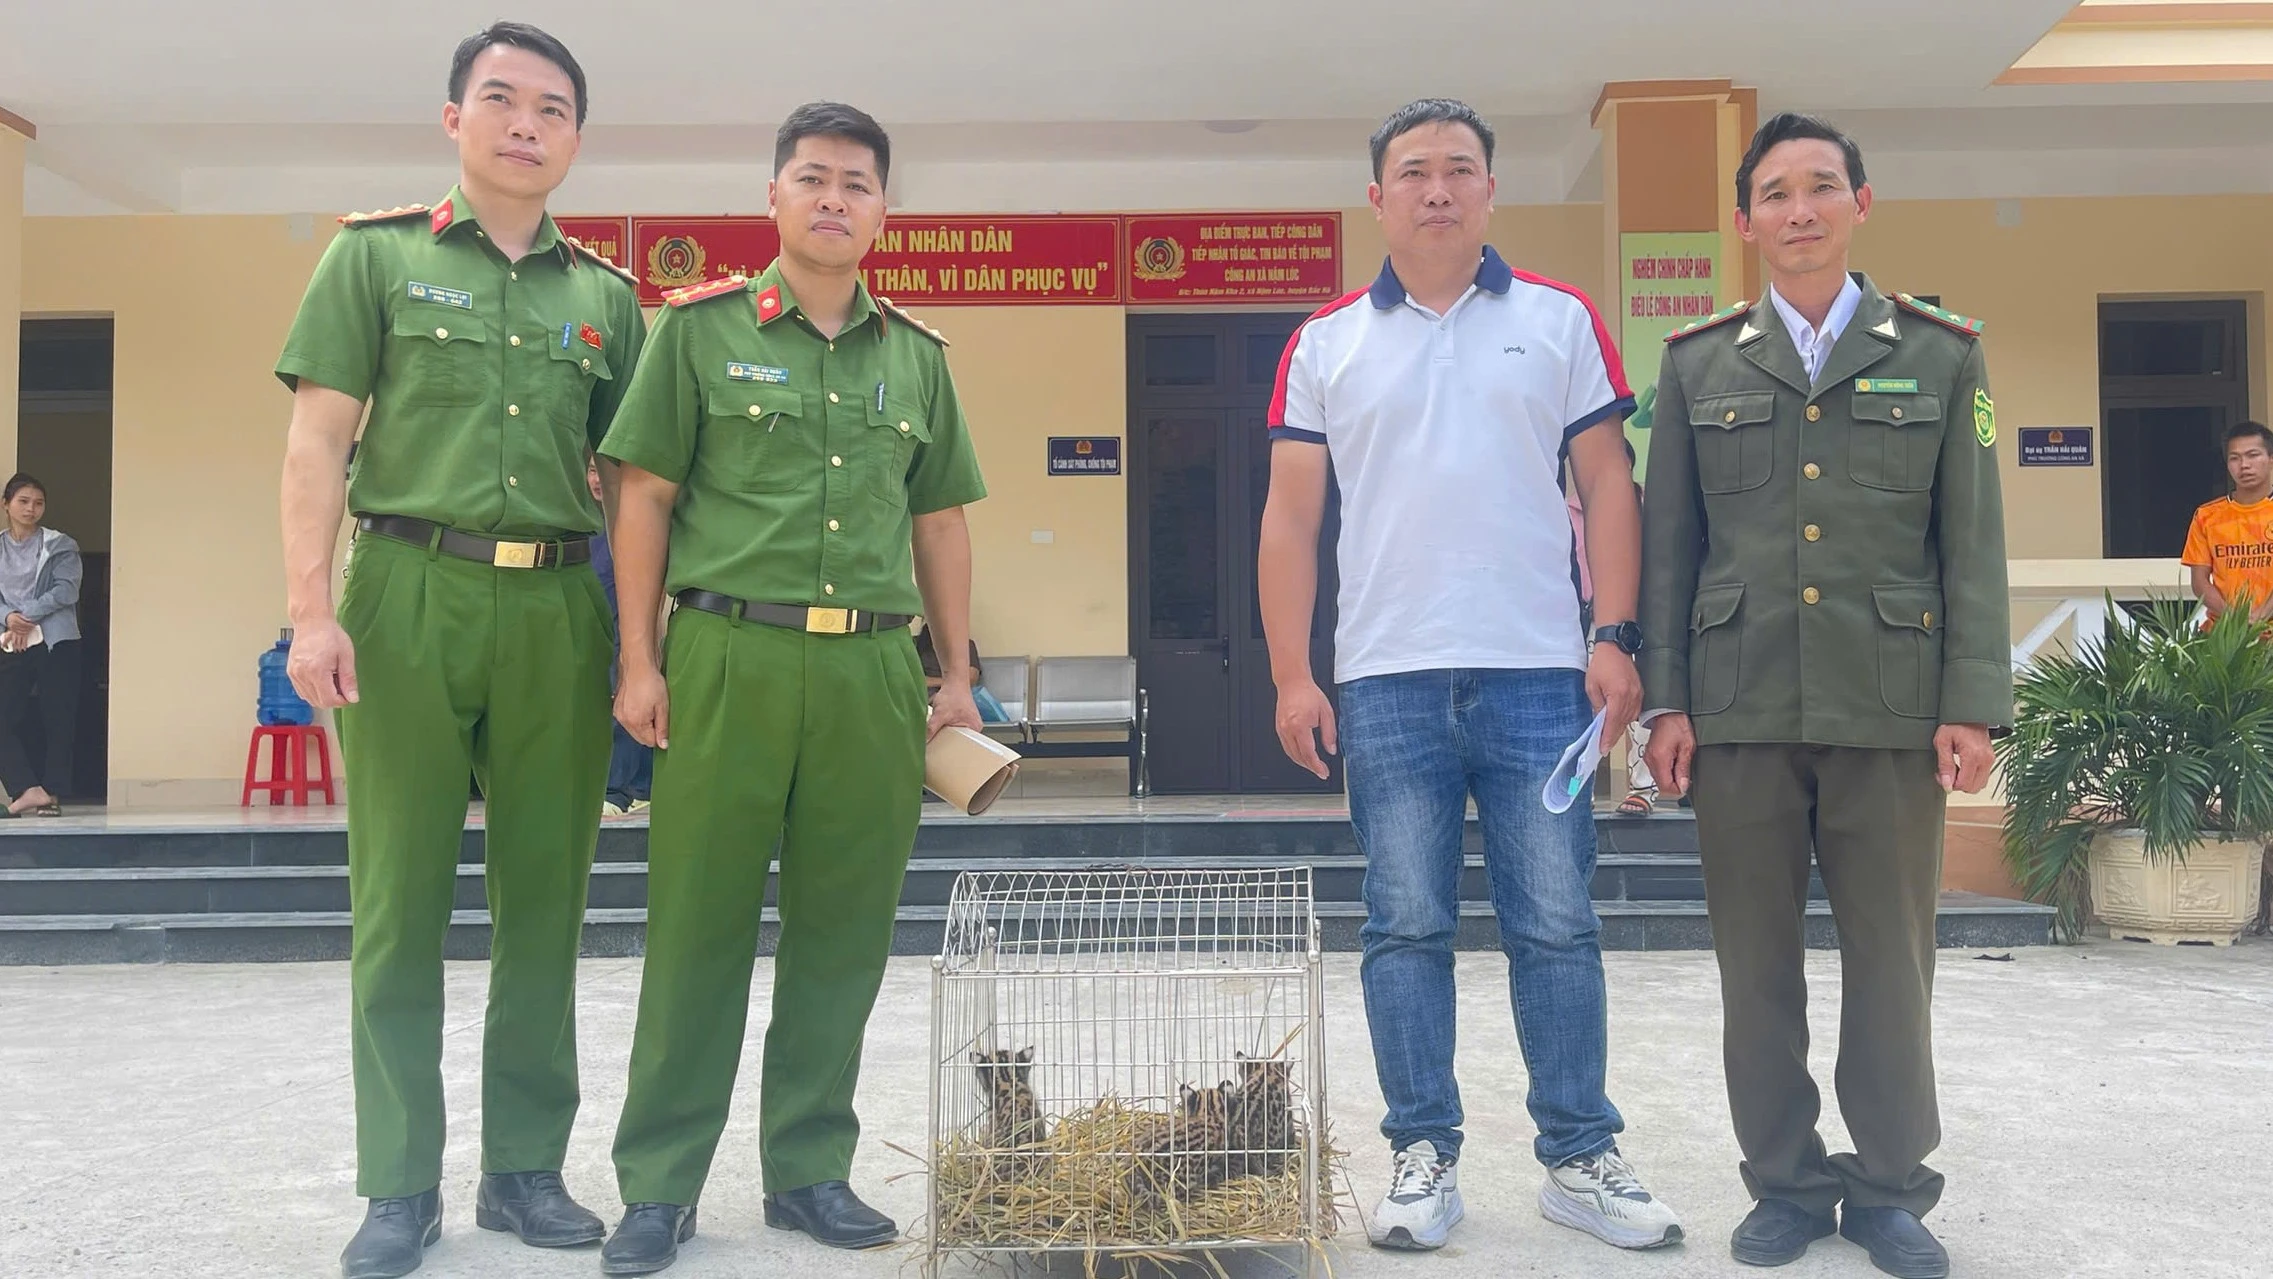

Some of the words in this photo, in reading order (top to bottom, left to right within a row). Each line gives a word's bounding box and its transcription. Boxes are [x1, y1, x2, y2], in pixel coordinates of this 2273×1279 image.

[874, 231, 902, 252] AN
[908, 226, 965, 252] NHÂN
[971, 226, 1013, 252] DÂN
[1270, 222, 1285, 239] TIẾP
[1286, 223, 1306, 239] CÔNG
[1307, 223, 1323, 239] DÂN
[601, 235, 617, 257] QUẢ
[1192, 244, 1207, 261] TIẾP
[1298, 243, 1310, 262] TỘI
[1310, 247, 1332, 262] PHẠM
[1224, 266, 1244, 281] CÔNG
[1245, 268, 1255, 281] AN
[1632, 253, 1656, 279] NGHIÊM
[1658, 251, 1676, 279] CHỈNH
[1677, 250, 1693, 279] CHẤP
[1694, 252, 1712, 279] HÀNH
[875, 264, 934, 294] THÂN,
[939, 264, 958, 291] VÌ
[964, 264, 1006, 291] DÂN
[1012, 268, 1065, 295] PHỤC
[1655, 291, 1671, 317] CÔNG
[1672, 295, 1681, 316] AN
[1682, 291, 1700, 316] NHÂN
[1700, 290, 1714, 316] DÂN
[1504, 346, 1525, 354] yody
[2240, 556, 2272, 569] BETTER
